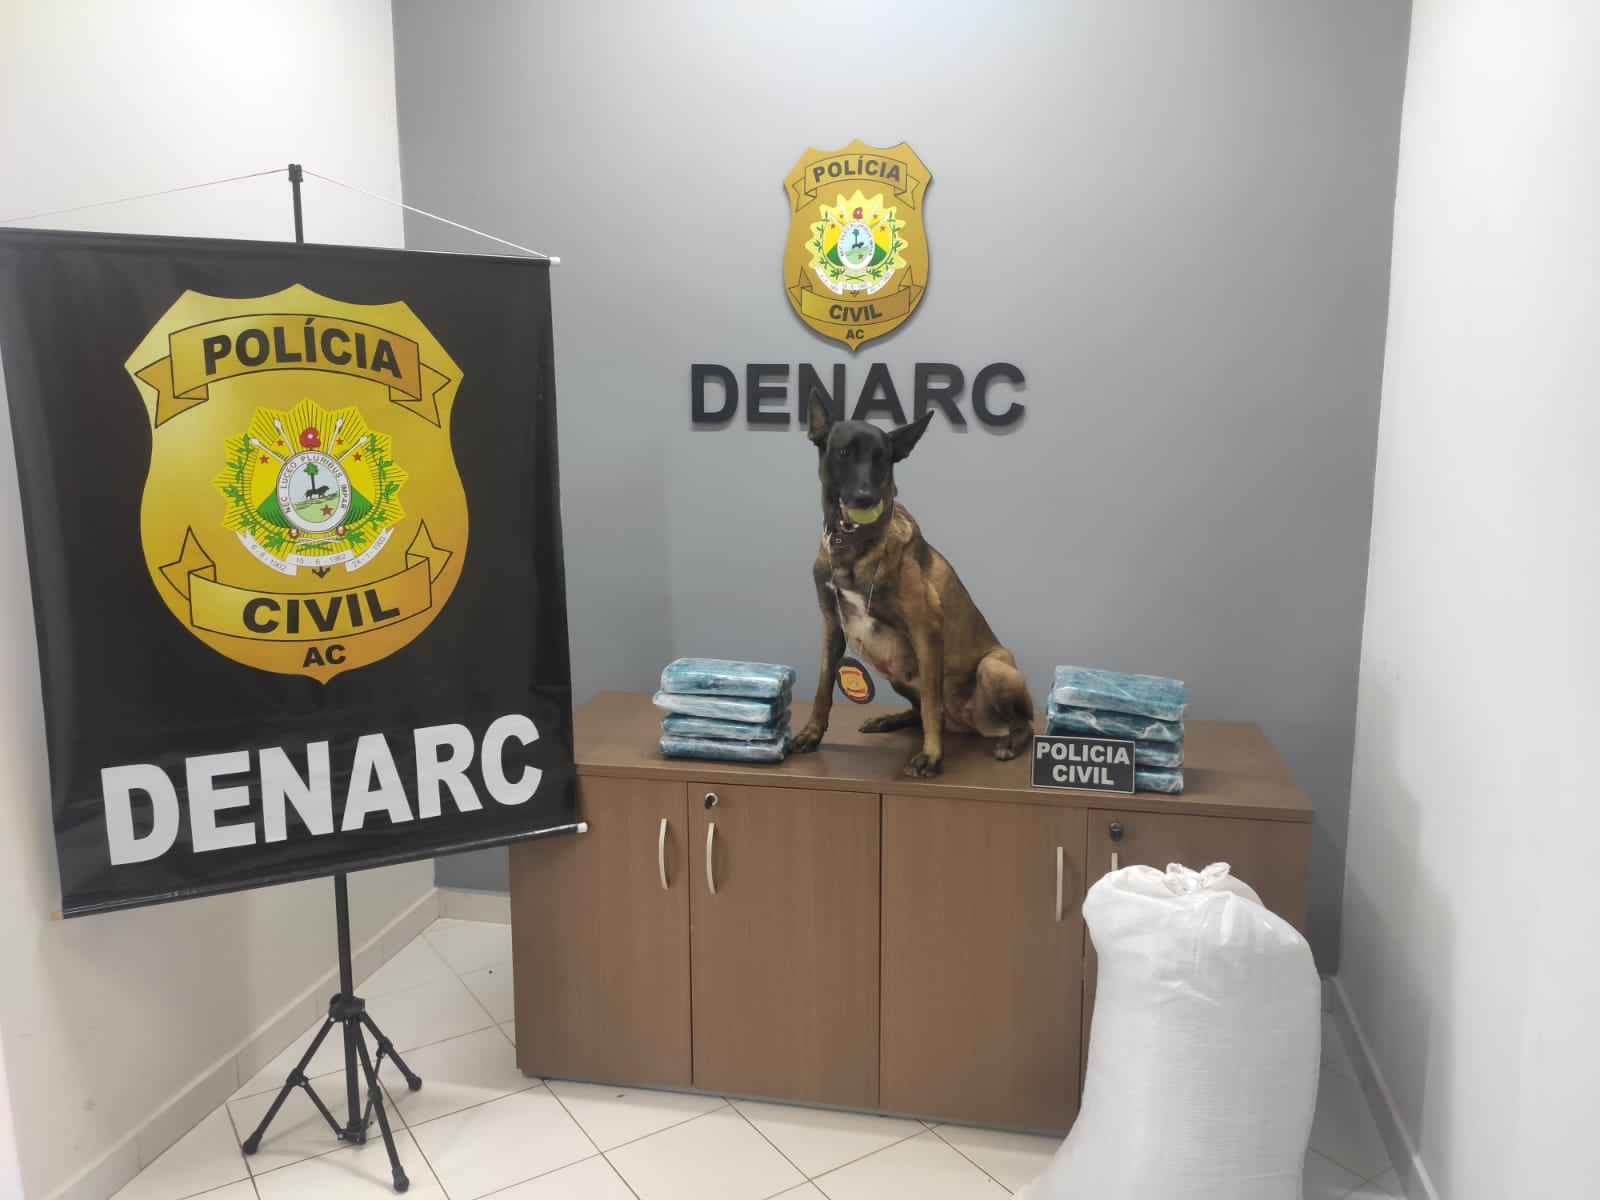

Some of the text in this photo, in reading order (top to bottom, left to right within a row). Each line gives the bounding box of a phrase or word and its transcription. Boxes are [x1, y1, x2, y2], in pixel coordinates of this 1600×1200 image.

[812, 154, 900, 183] POLÍCIA
[829, 304, 883, 322] CIVIL
[846, 329, 865, 340] AC
[202, 317, 403, 379] POLÍCIA
[690, 362, 1026, 427] DENARC
[242, 589, 400, 634] CIVIL
[303, 644, 346, 667] AC
[1036, 742, 1130, 765] POLICIA
[1052, 764, 1115, 786] CIVIL
[100, 713, 543, 867] DENARC
